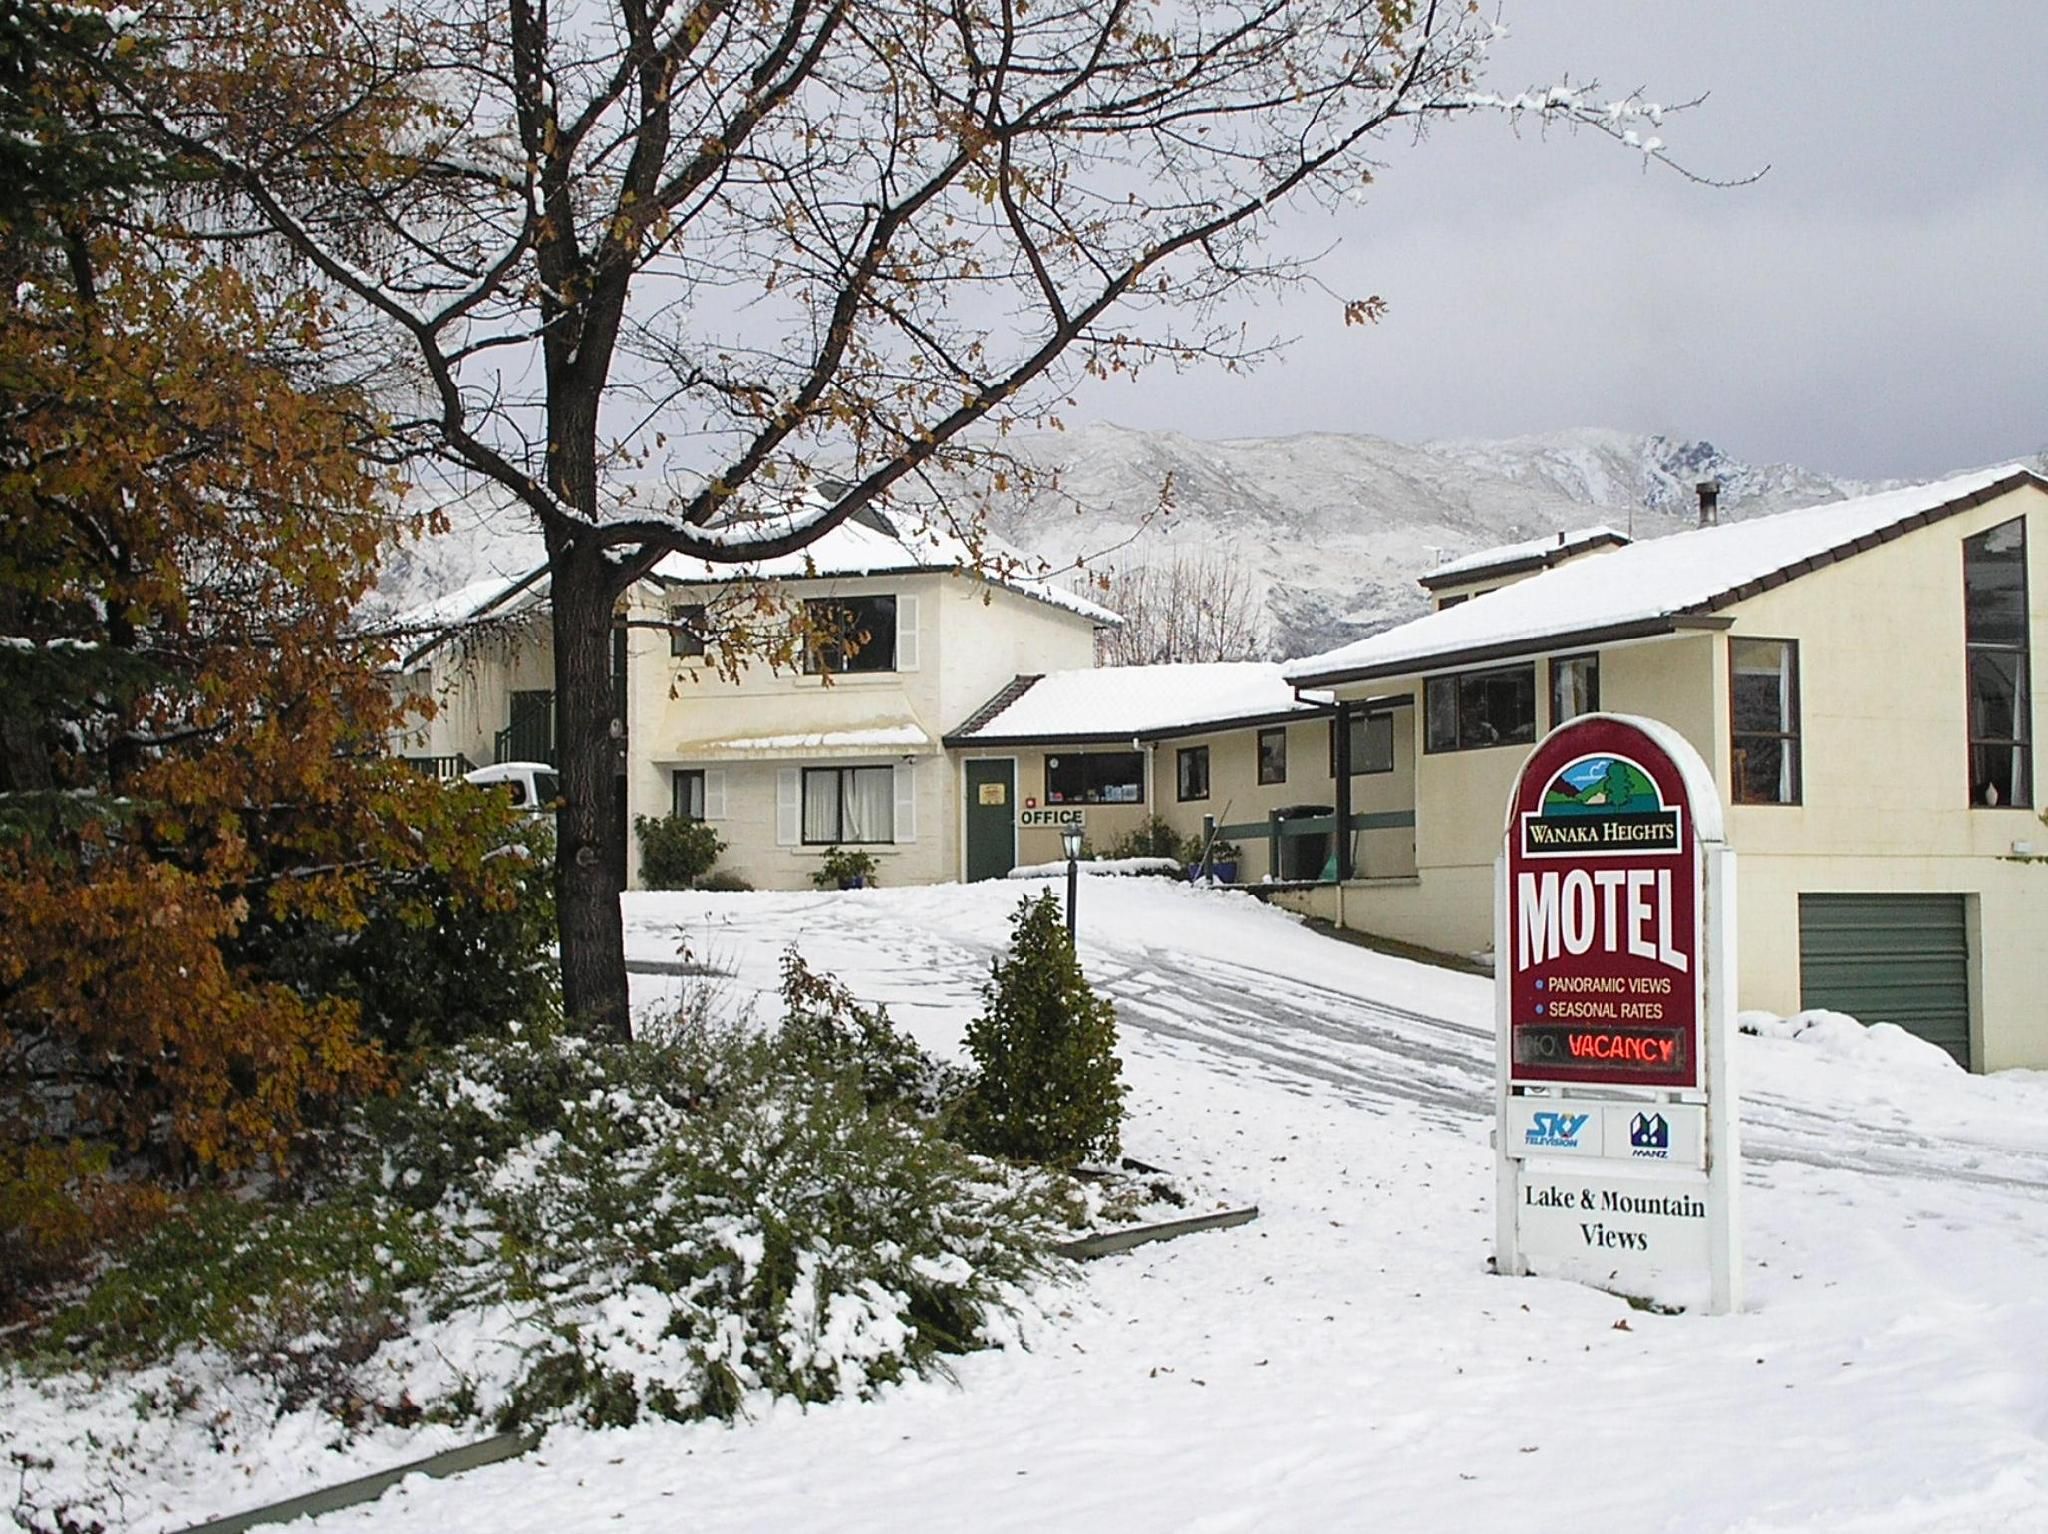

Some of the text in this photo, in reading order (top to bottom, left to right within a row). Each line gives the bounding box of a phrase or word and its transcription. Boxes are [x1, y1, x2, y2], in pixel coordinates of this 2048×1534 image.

[1022, 810, 1083, 824] OFFICE
[1530, 822, 1674, 844] WANAKA HEIGHTS
[1518, 869, 1688, 973] MOTEL
[1549, 976, 1671, 993] PANORAMIC VIEWS
[1549, 1002, 1663, 1019] SEASONAL RATES
[1568, 1034, 1674, 1061] VACANCY
[1525, 1112, 1589, 1138] SKY
[1525, 1136, 1578, 1147] TELEVISION
[1525, 1185, 1706, 1218] Lake & Mountain
[1581, 1223, 1648, 1251] Views
